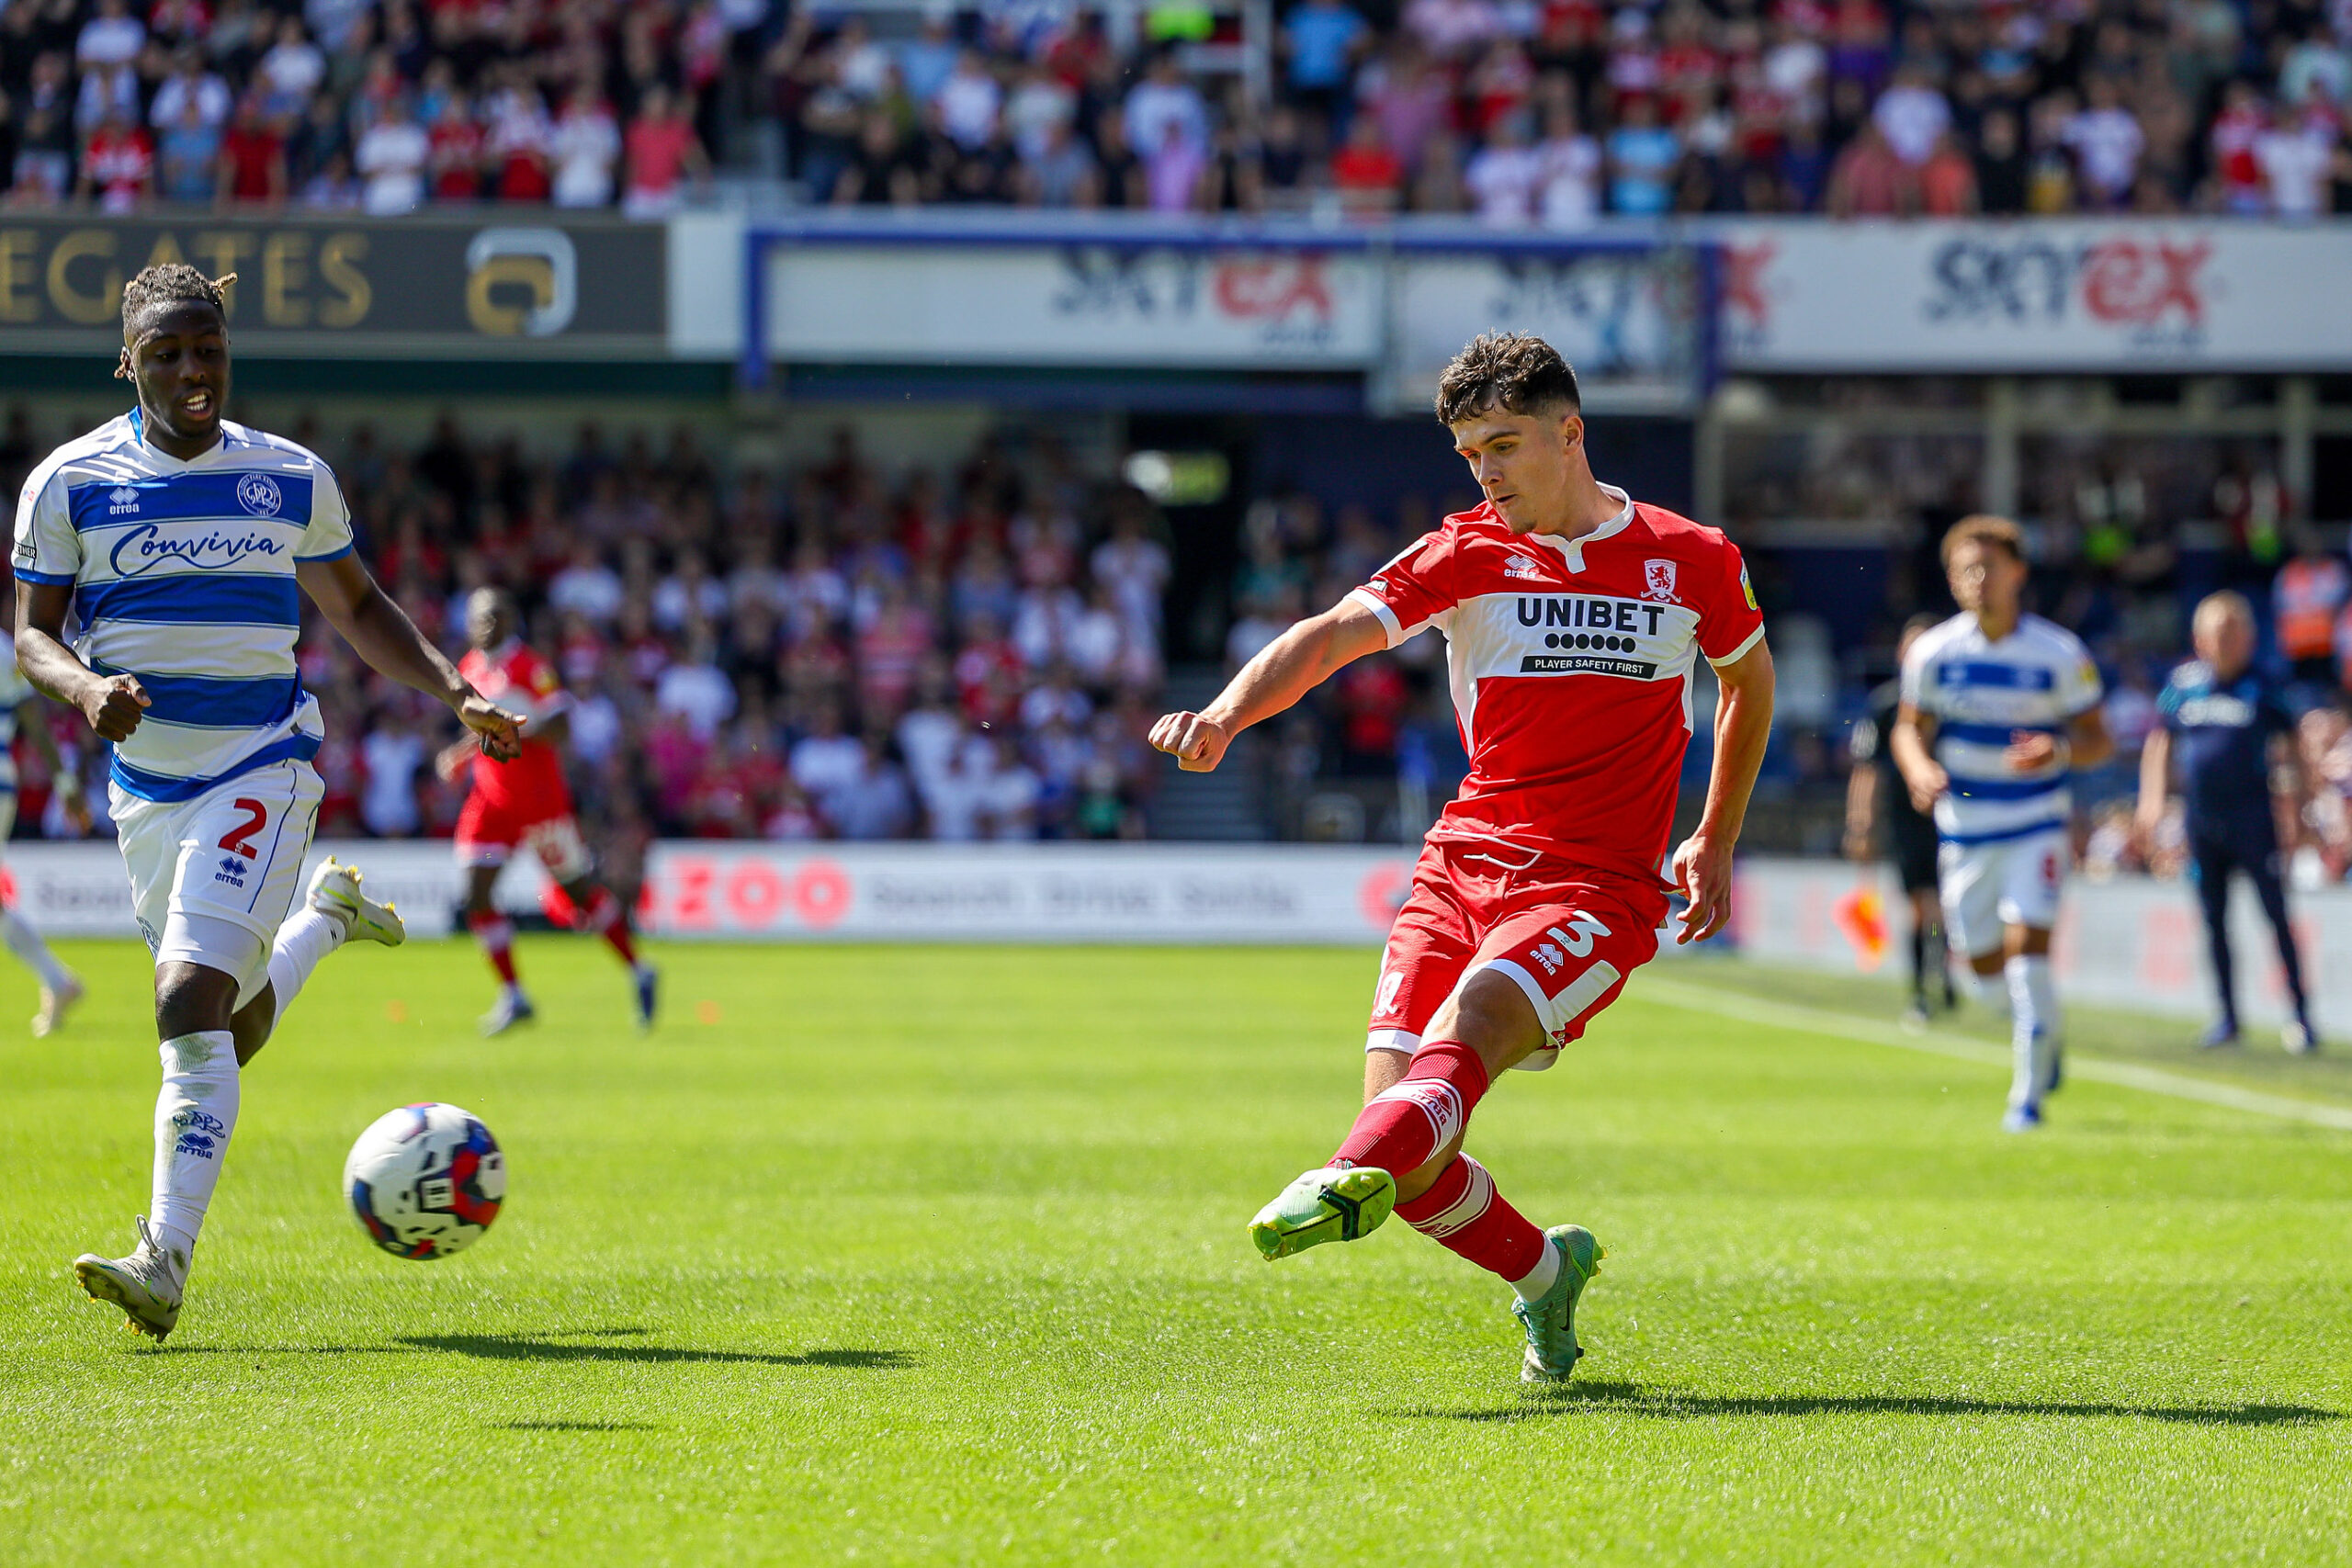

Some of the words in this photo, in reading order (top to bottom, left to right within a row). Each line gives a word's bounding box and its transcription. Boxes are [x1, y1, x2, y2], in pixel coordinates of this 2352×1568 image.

[109, 524, 285, 577] Convivia
[1518, 598, 1665, 636] UNIBET
[1534, 659, 1573, 669] PLAYER
[1575, 659, 1614, 671] SAFETY
[1616, 662, 1645, 674] FIRST
[218, 798, 266, 860] 2
[1546, 909, 1612, 958] 3
